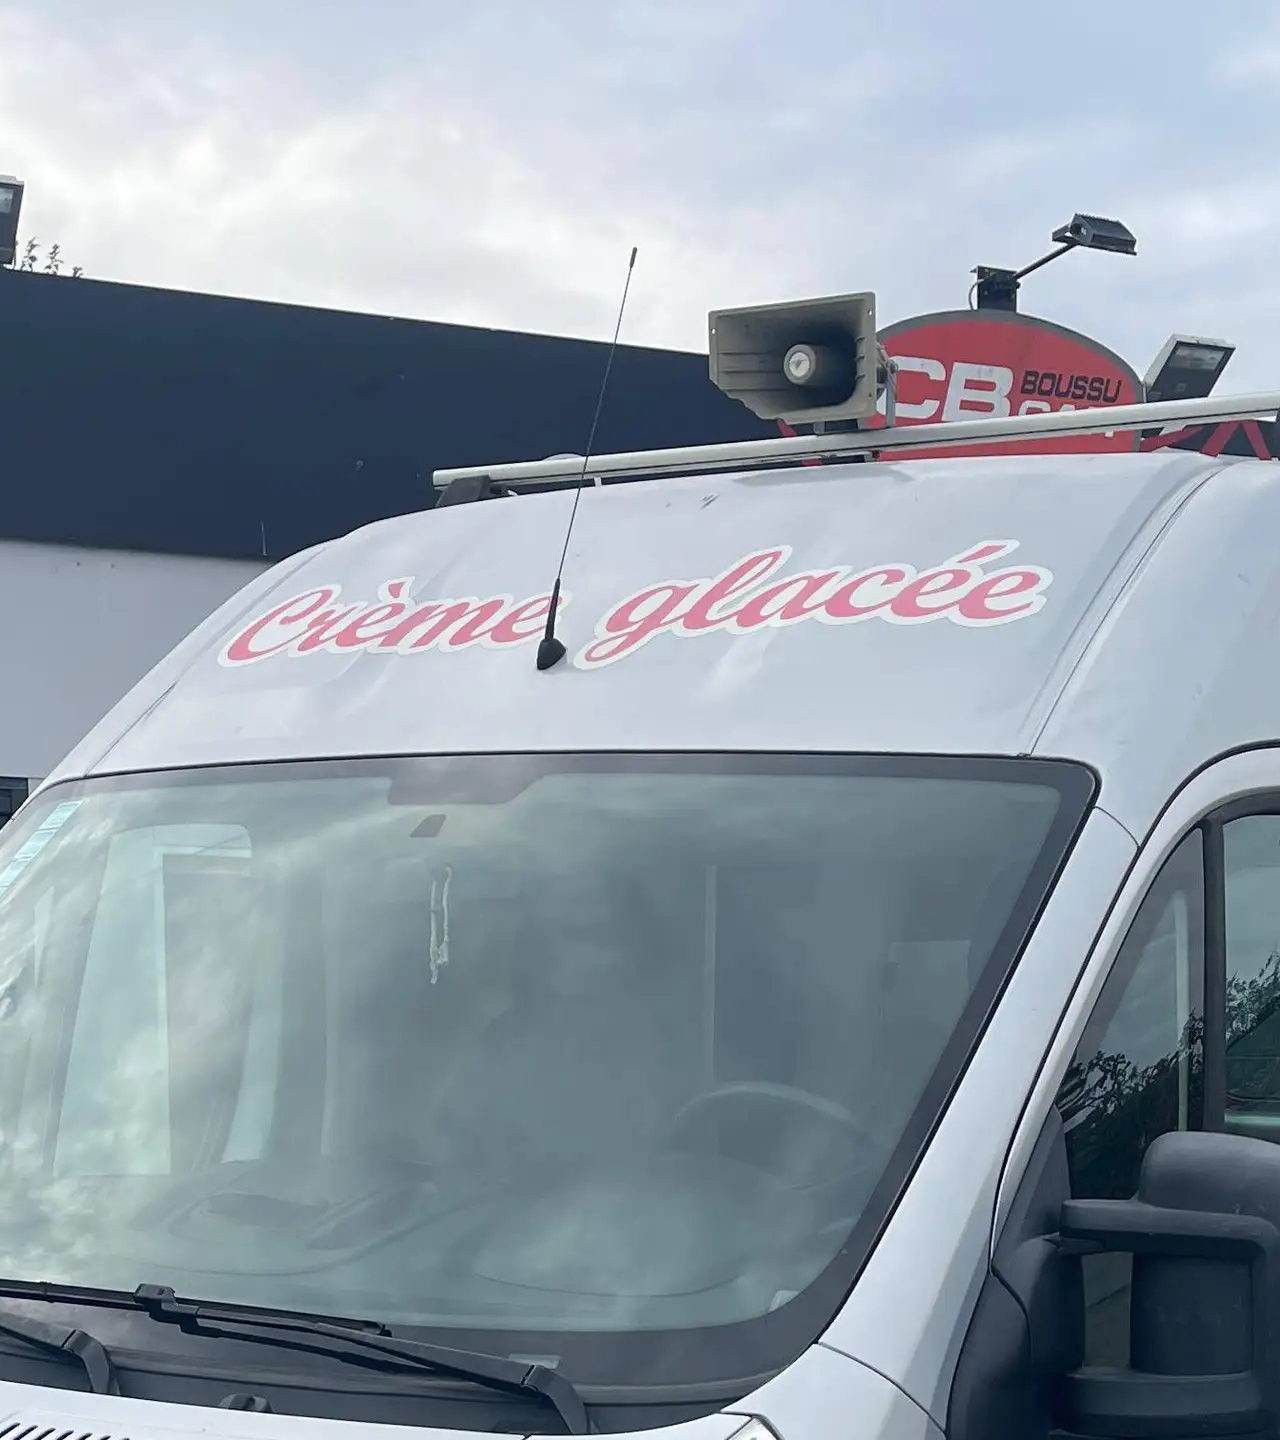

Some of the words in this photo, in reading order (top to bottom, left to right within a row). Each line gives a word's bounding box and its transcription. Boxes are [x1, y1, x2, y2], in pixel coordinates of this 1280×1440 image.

[877, 355, 1014, 421] CB
[1019, 370, 1122, 404] BOUSSU
[223, 574, 565, 664] Crème
[580, 541, 1050, 666] glacée
